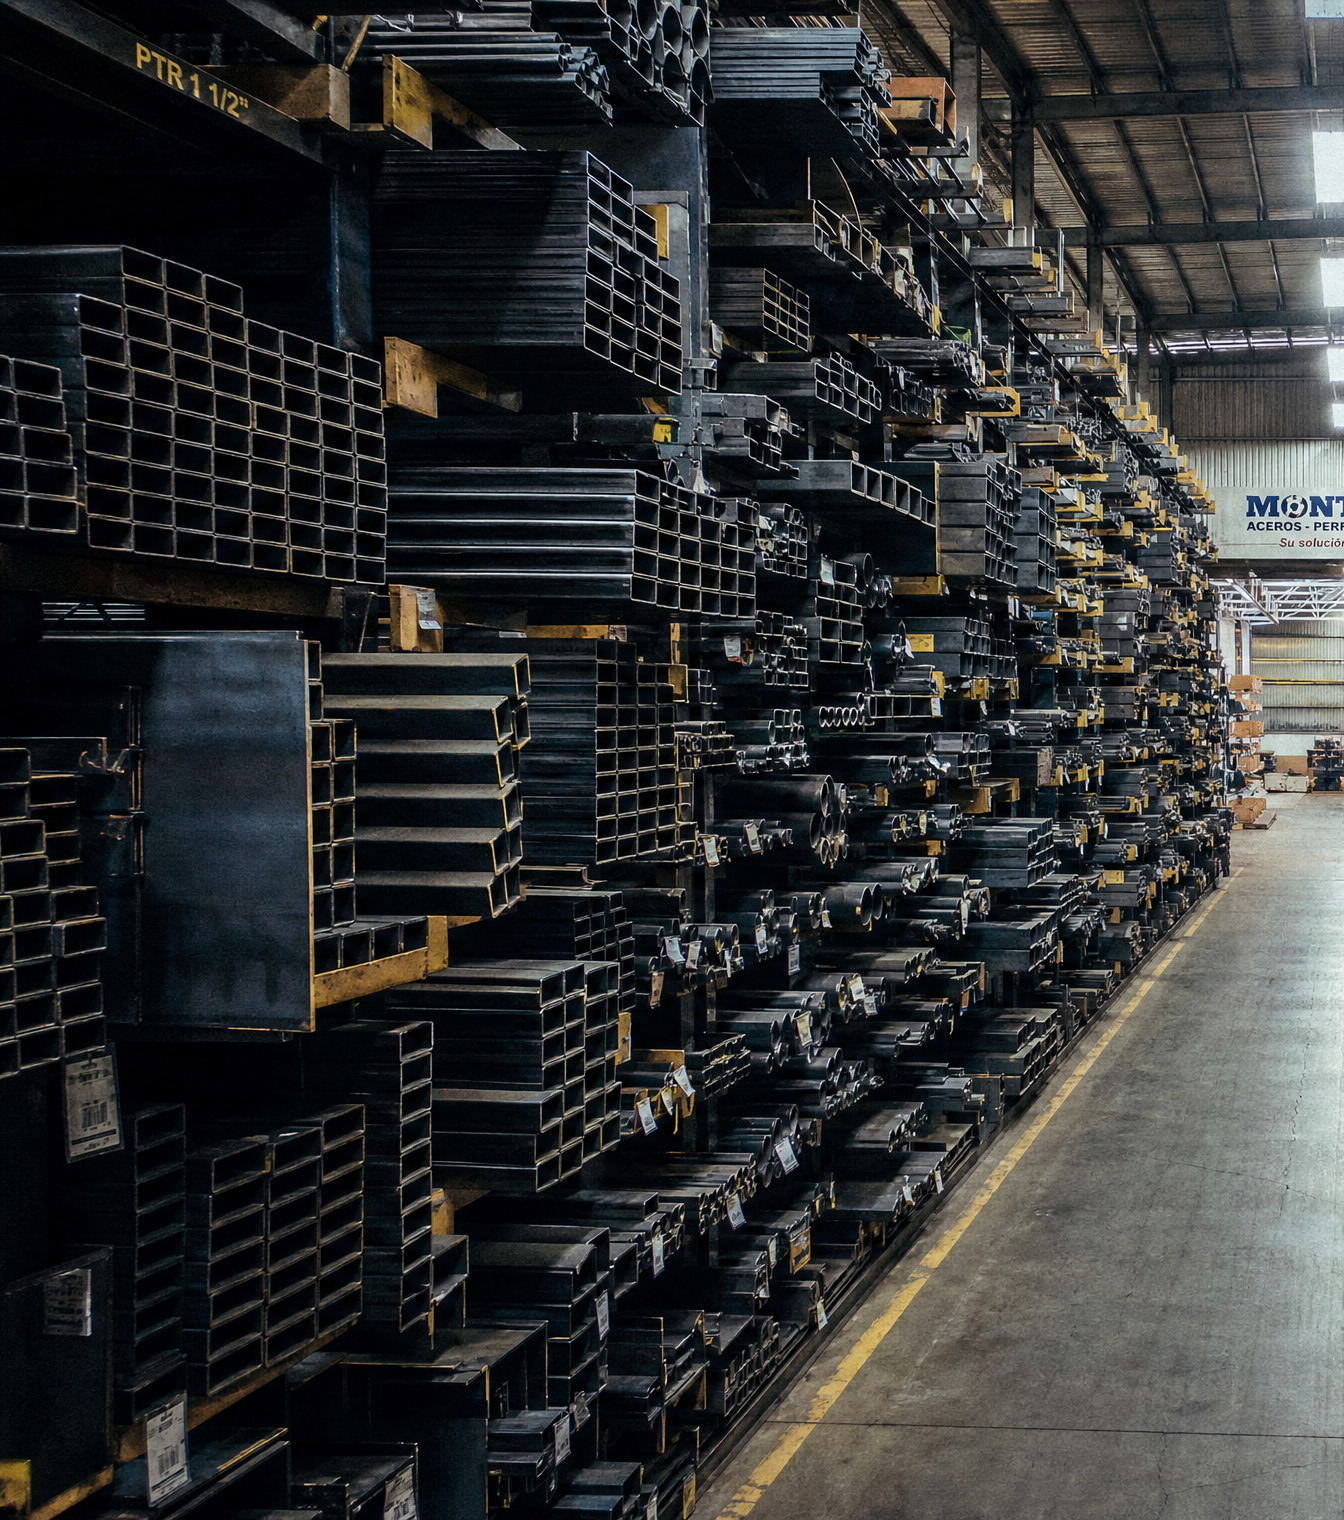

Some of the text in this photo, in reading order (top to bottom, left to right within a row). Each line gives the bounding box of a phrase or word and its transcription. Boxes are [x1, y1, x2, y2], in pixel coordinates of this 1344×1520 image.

[136, 42, 185, 91] PTR
[190, 73, 200, 99] 1
[1246, 521, 1302, 532] ACEROS
[1279, 537, 1295, 548] Su
